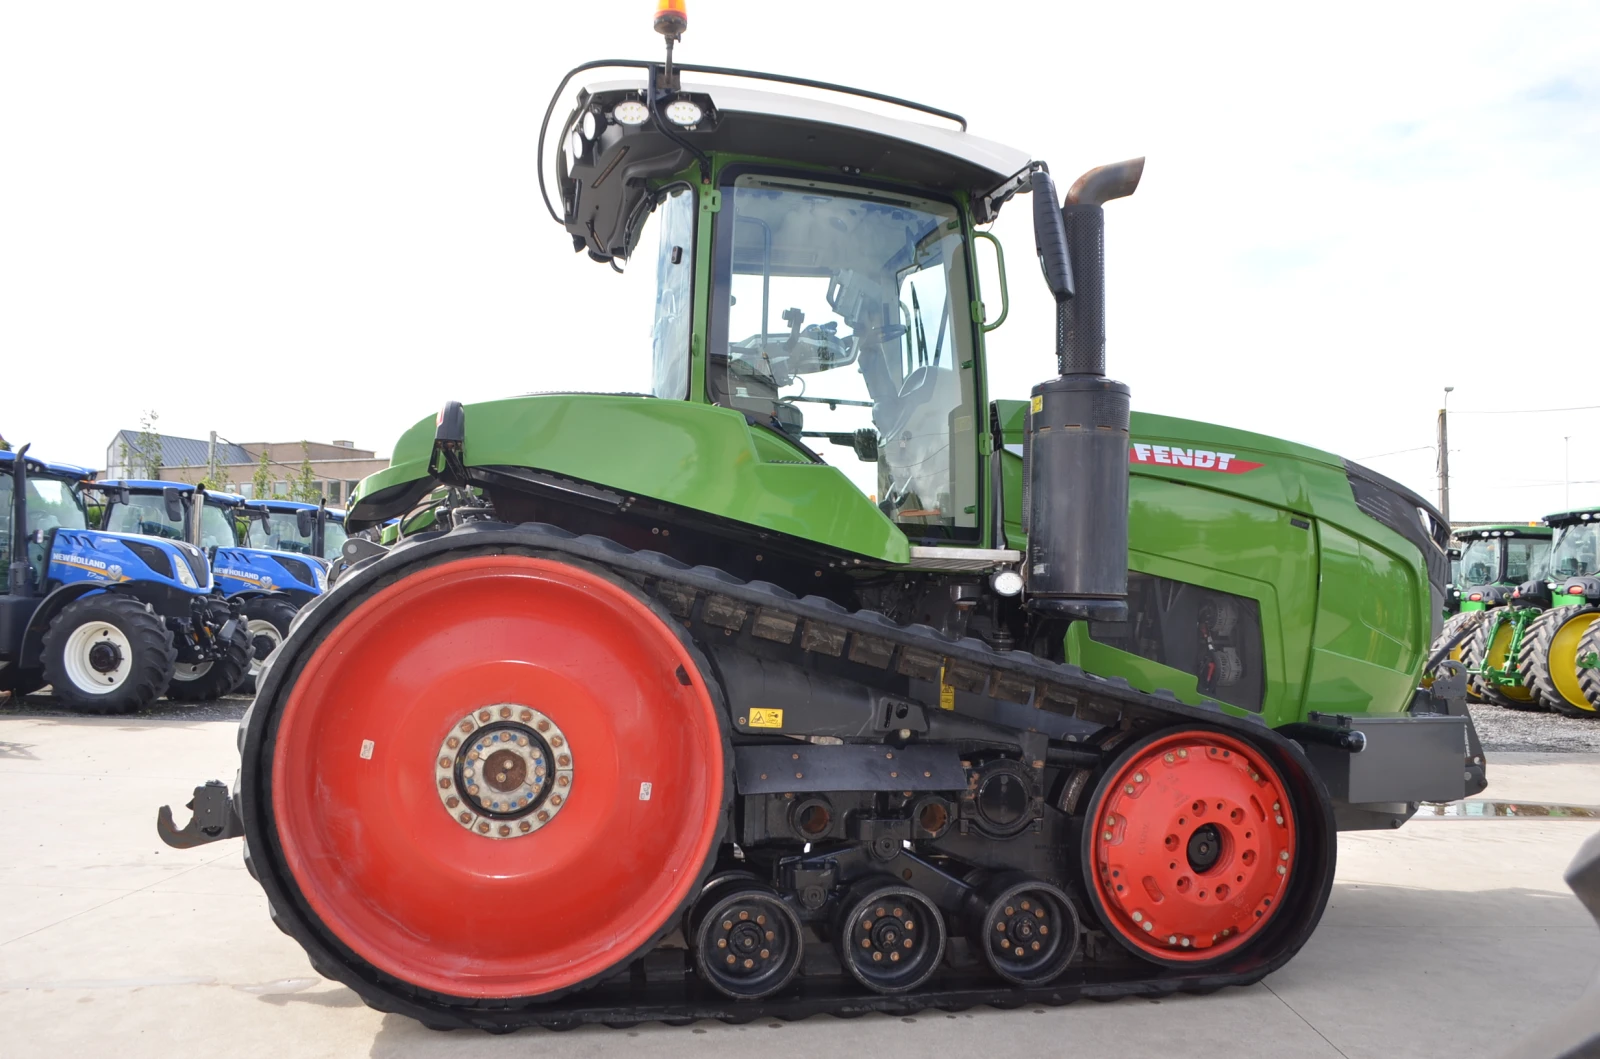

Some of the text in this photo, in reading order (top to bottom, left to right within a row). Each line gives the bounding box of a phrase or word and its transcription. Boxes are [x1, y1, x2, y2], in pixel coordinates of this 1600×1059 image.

[1133, 443, 1236, 470] FENDT
[53, 553, 106, 569] NEW HOLLAND
[229, 569, 259, 580] HOLLAND
